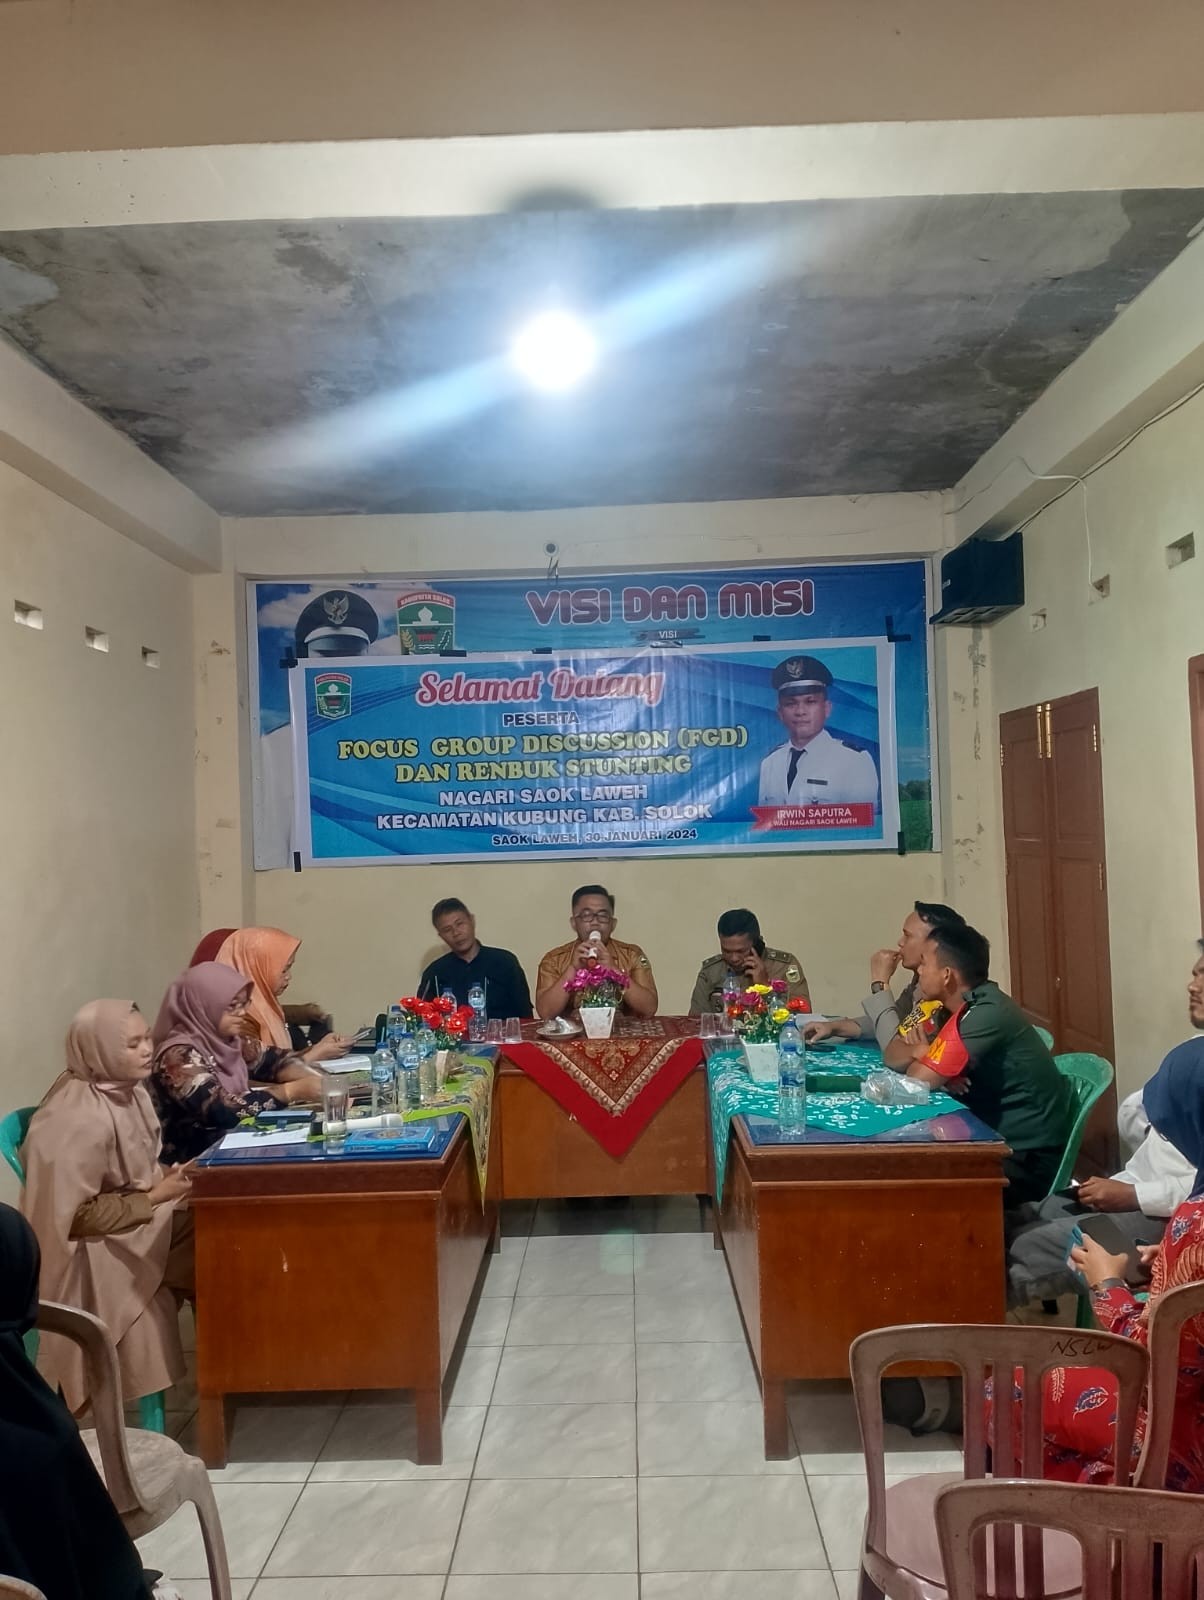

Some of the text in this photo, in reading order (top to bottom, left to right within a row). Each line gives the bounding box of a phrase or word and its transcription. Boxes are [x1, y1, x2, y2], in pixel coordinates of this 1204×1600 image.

[526, 578, 815, 626] VISI DAN MISI
[658, 630, 678, 639] VISI
[416, 667, 665, 706] Selamat Datang
[503, 711, 579, 727] PESERTA
[338, 725, 748, 759] FOCUS GROUP DISCUSSION (FGD)
[395, 754, 692, 783] DAN RENBUK STUNTING
[439, 785, 648, 806] NAGARI SAOK LAWEH
[377, 804, 712, 829] KECAMATAN KUBUNG KAB. SOLOK
[777, 807, 852, 819] IRWIN SAPUTRA
[492, 828, 697, 845] SAOK LAWEH, 30 JANUARI 2024
